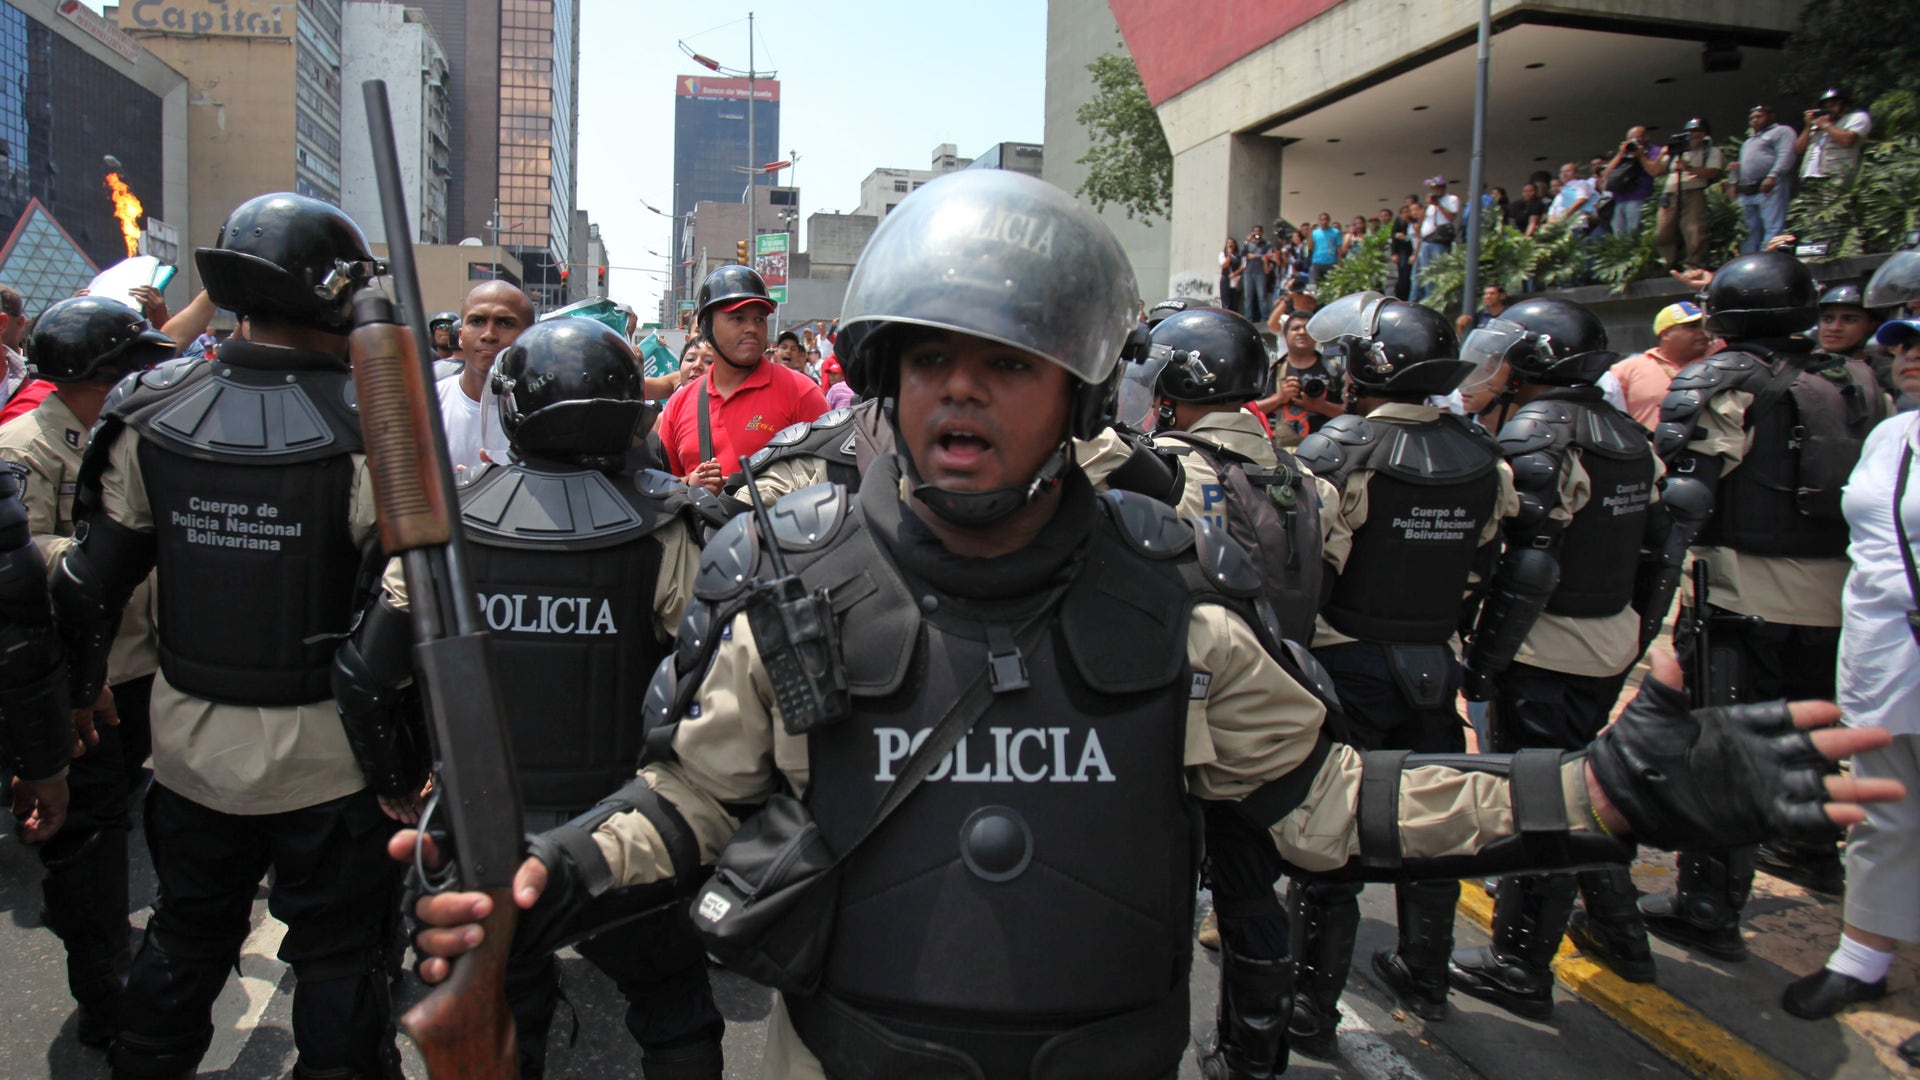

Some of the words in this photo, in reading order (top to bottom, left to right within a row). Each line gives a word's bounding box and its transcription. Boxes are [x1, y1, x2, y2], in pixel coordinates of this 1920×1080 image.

[703, 86, 725, 94] Banco
[736, 88, 772, 97] Venzuela
[189, 496, 248, 517] Cuerpo
[256, 503, 278, 518] de
[1411, 506, 1450, 518] Cuerpo
[1454, 507, 1466, 517] de
[226, 518, 302, 537] Nacional
[1435, 519, 1476, 529] Nacional
[187, 528, 281, 551] Bolivariana
[1404, 528, 1464, 540] Bolivariana
